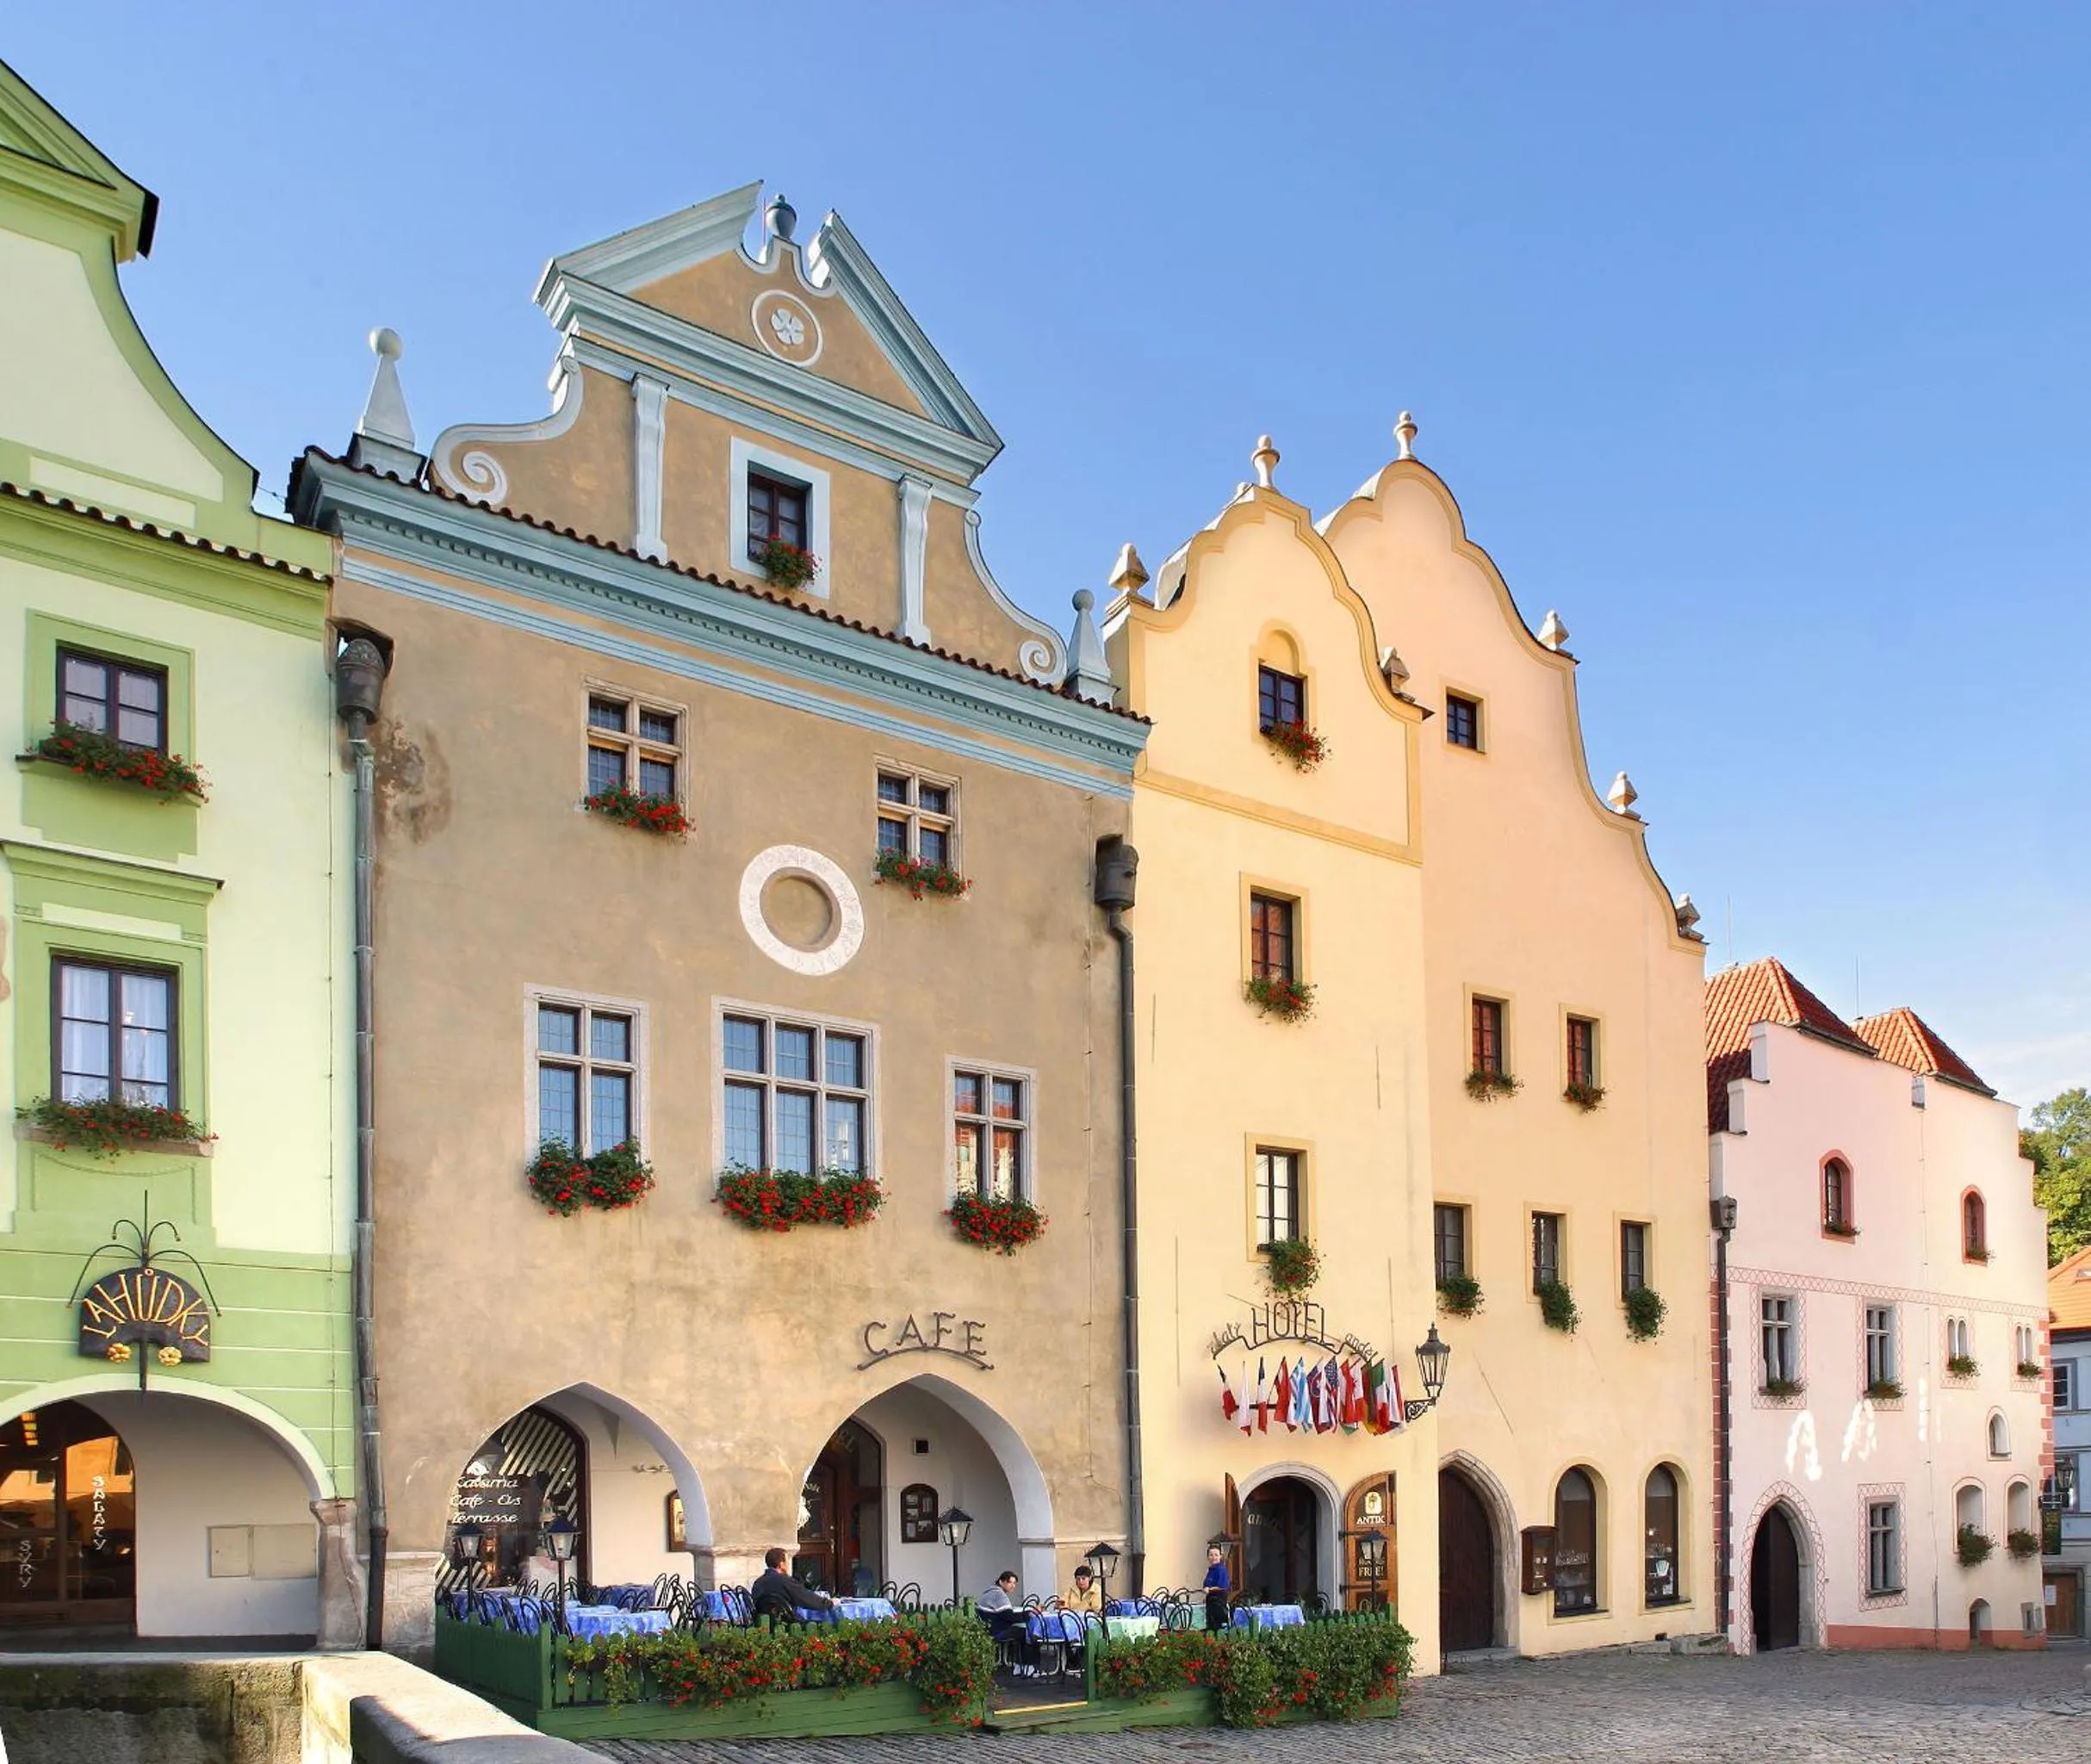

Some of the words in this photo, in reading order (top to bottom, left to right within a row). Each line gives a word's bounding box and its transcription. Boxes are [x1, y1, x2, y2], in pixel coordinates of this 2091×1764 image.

[83, 1268, 209, 1346] LAHŮDKY
[1250, 1298, 1335, 1347] HOTEL
[864, 1311, 987, 1357] CAFE
